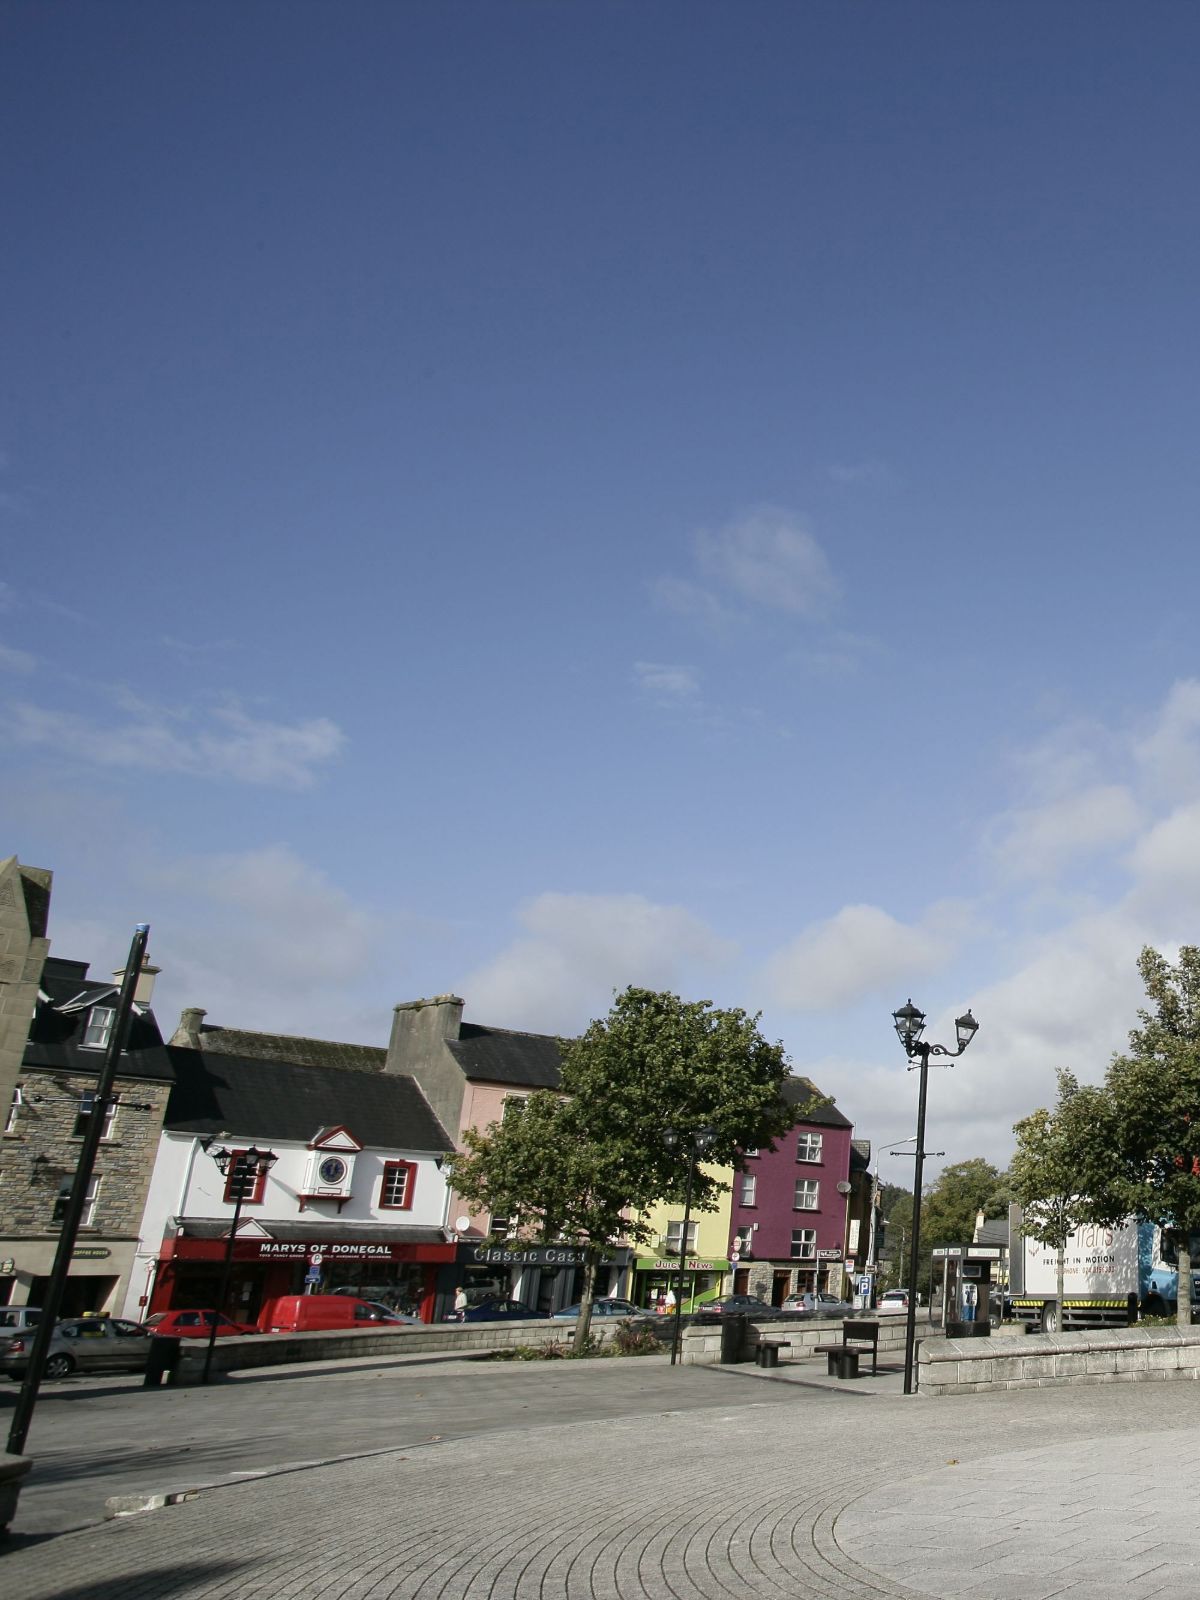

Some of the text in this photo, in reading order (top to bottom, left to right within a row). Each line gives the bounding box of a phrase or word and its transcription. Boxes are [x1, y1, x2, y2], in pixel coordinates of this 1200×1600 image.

[260, 1243, 392, 1254] MARYS OF DONEGAL
[473, 1249, 537, 1262] Classic
[1085, 1255, 1115, 1263] MOTION
[655, 1260, 681, 1269] JUIC
[861, 1283, 869, 1294] P
